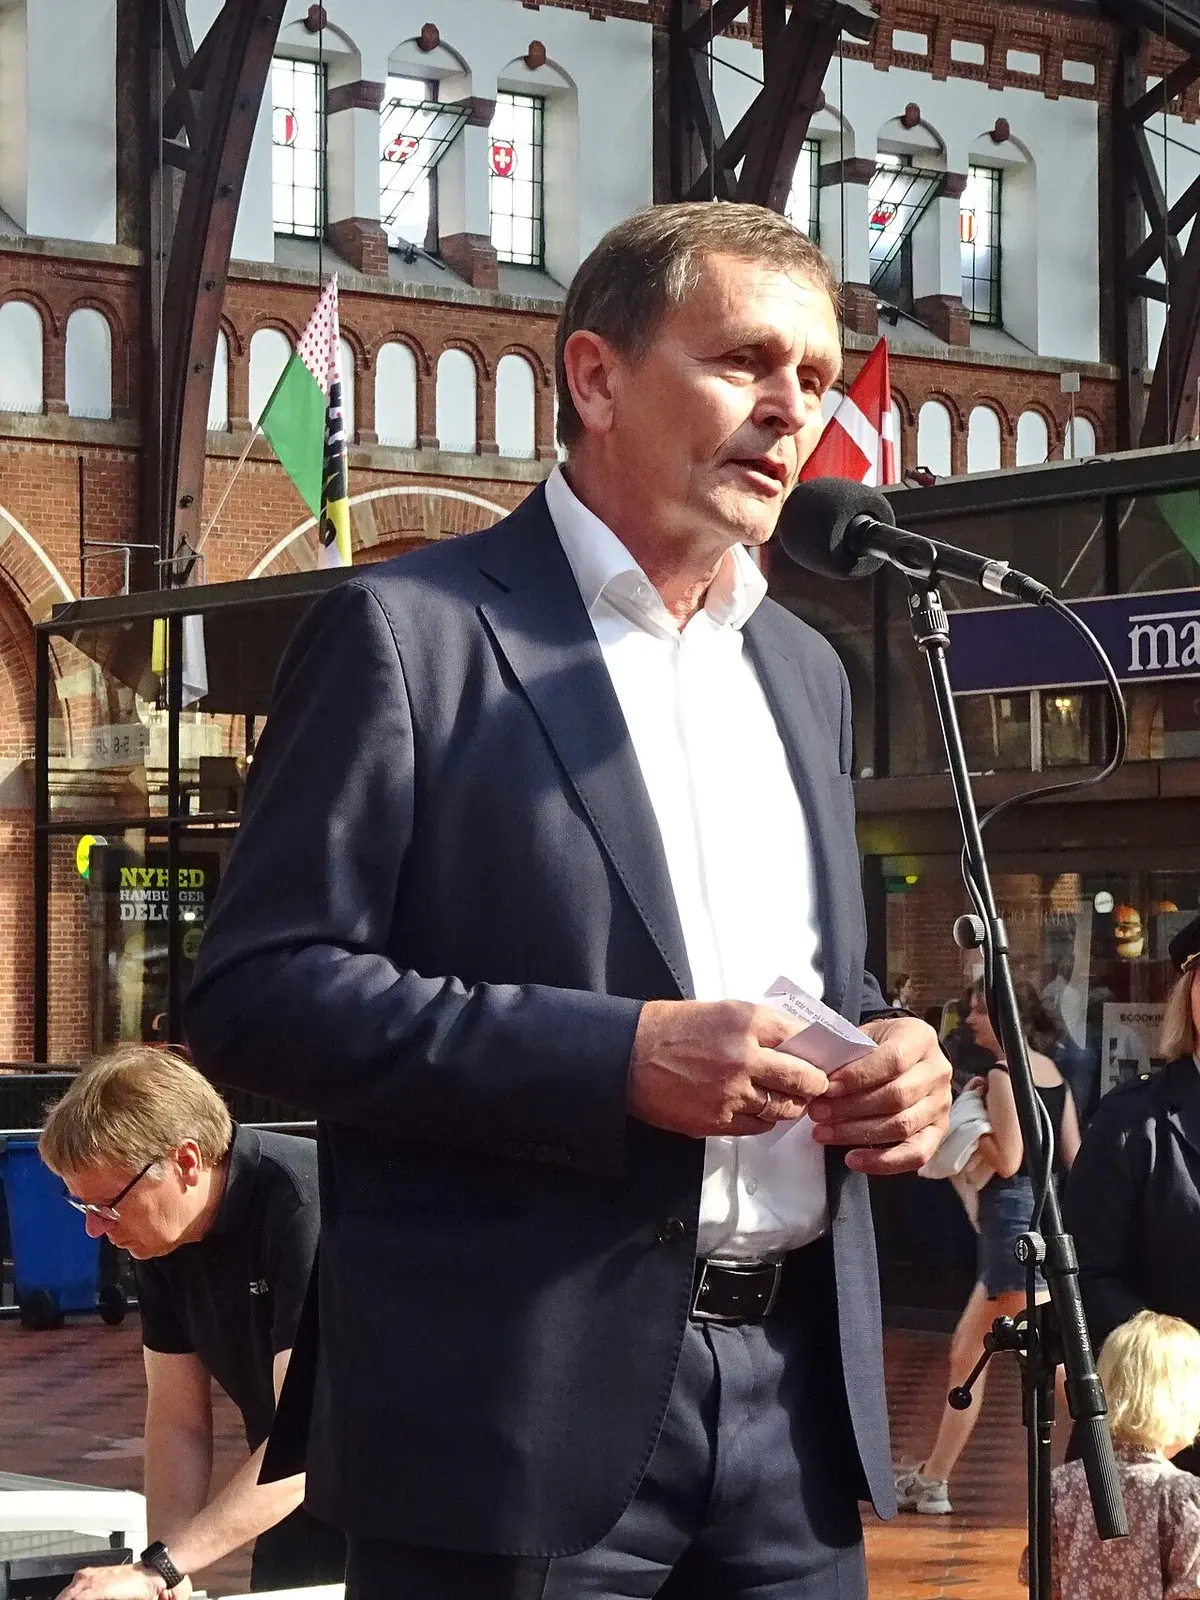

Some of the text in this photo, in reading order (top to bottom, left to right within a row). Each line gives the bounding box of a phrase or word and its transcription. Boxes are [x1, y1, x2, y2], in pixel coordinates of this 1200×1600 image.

[1128, 620, 1200, 671] ma
[120, 867, 205, 887] NYHED
[120, 889, 205, 902] HAMBUGER
